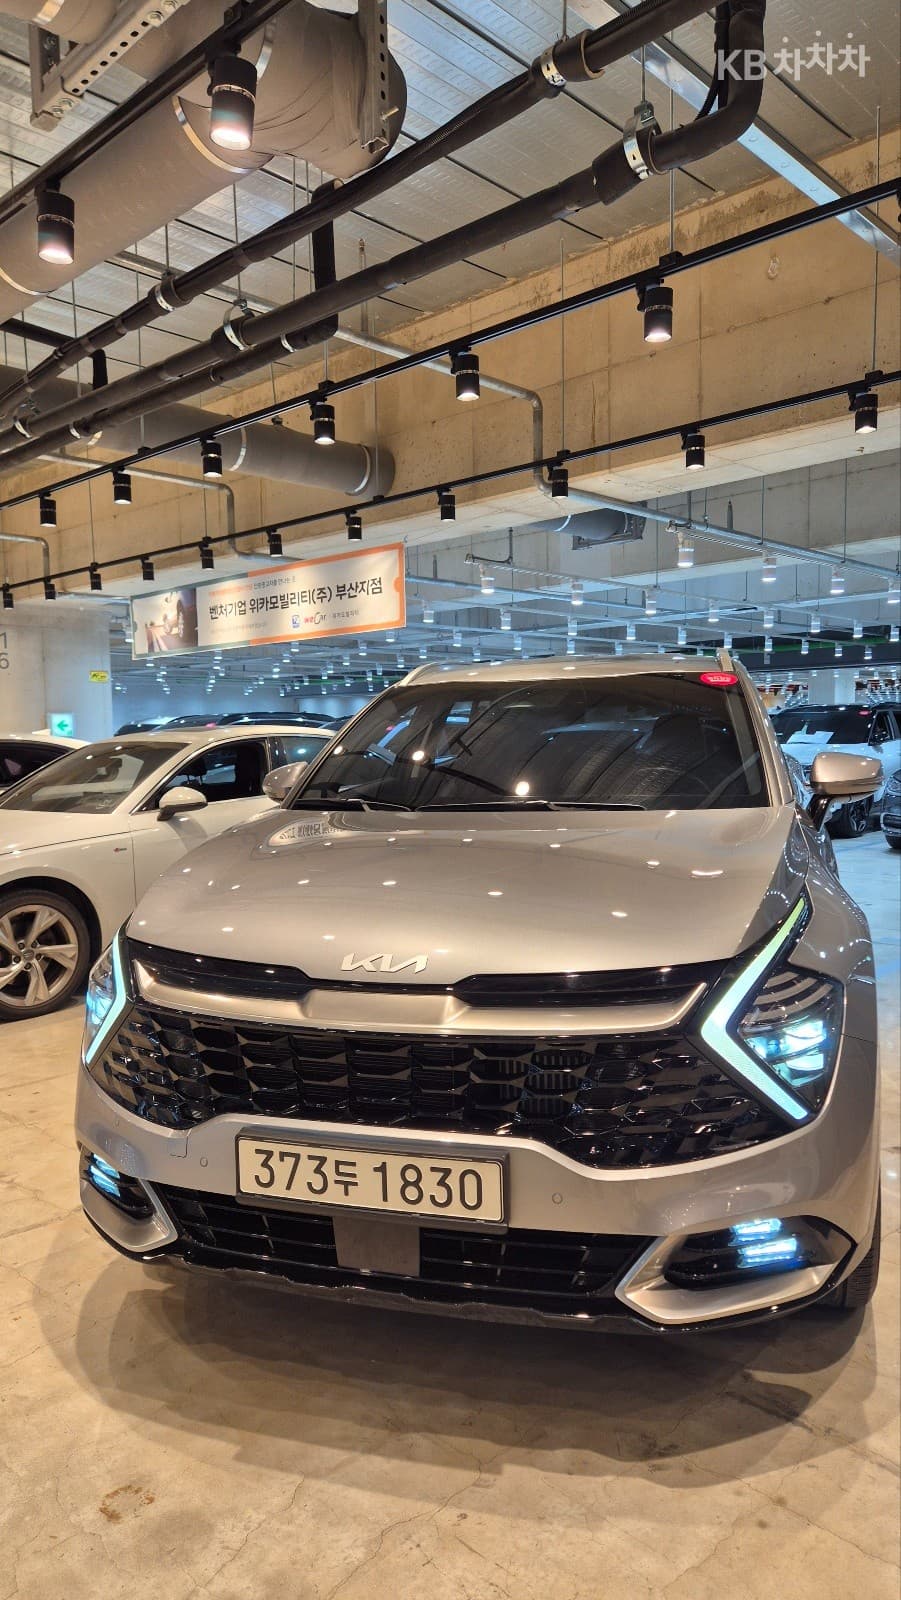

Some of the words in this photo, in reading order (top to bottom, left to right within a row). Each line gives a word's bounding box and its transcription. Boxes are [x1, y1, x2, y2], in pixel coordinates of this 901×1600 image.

[209, 601, 247, 621] 벤처기업
[249, 586, 333, 613] 위카모빌리티(주)
[335, 577, 383, 601] 부산지점
[340, 952, 428, 974] KIA
[254, 1149, 358, 1196] 373두
[372, 1161, 483, 1211] 1830
